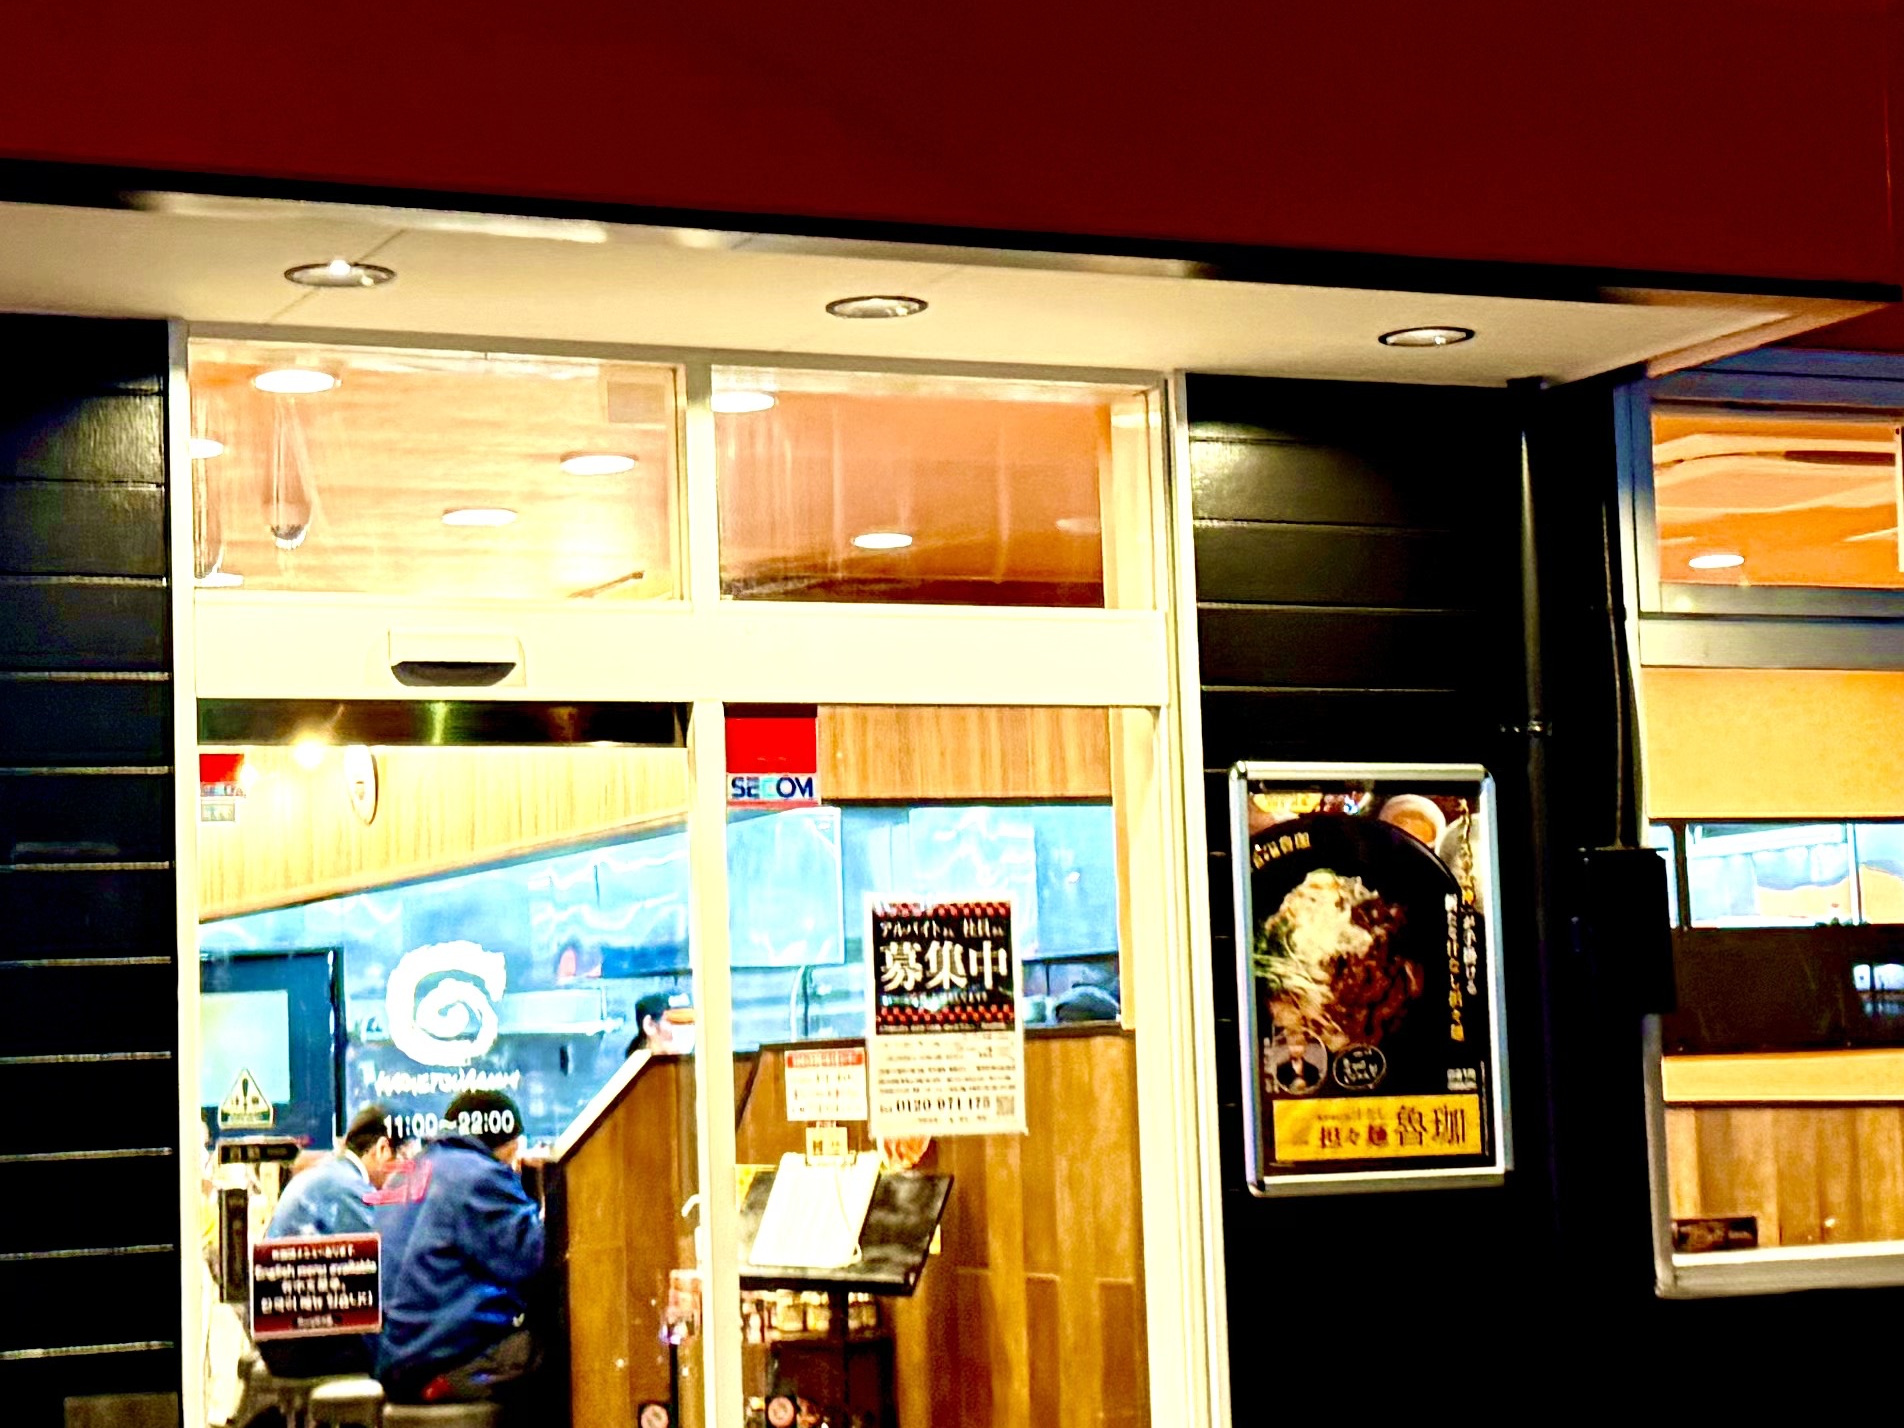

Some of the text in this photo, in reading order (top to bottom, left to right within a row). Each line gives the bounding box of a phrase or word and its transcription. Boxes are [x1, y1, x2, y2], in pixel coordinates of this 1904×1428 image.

[731, 776, 814, 799] SECOM
[880, 940, 1008, 992] 募集中
